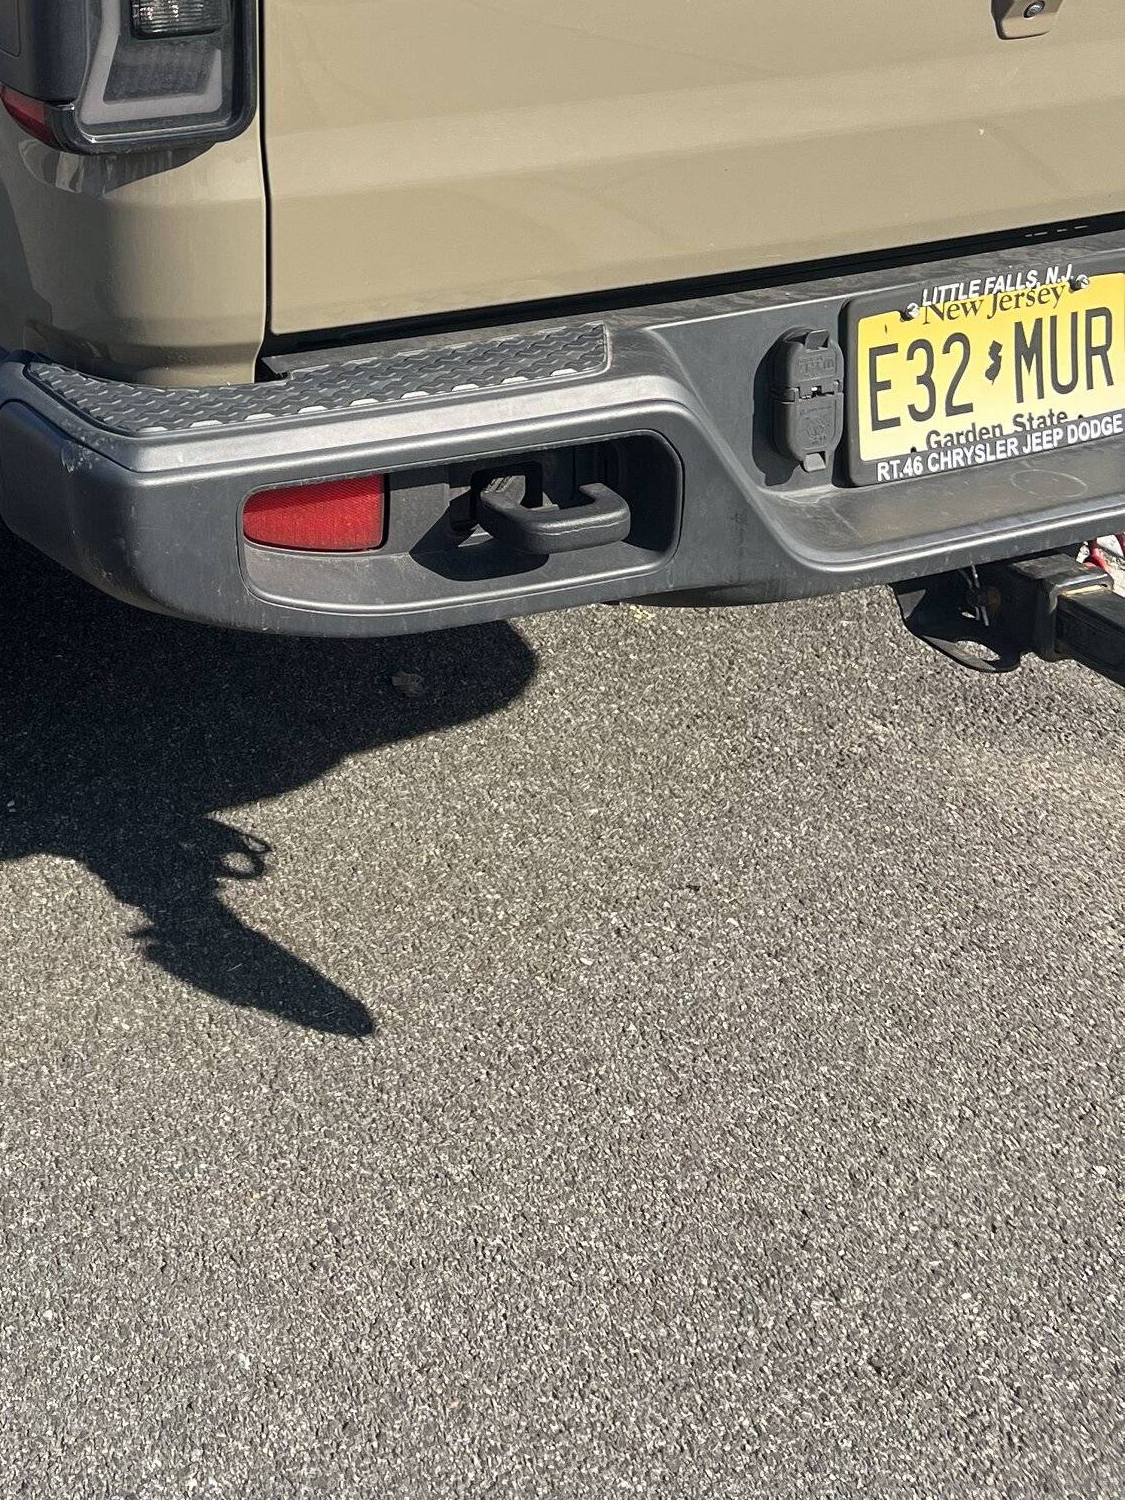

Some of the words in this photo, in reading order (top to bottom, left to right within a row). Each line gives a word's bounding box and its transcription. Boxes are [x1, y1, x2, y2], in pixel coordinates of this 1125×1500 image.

[922, 279, 981, 308] LITTLE
[1045, 263, 1074, 285] N.J.
[923, 299, 985, 325] New
[987, 284, 1066, 319] Jersey
[868, 332, 974, 431] E32
[1014, 306, 1115, 404] MUR
[877, 456, 924, 482] RT.46
[927, 437, 1019, 473] CHRYSLER
[1023, 428, 1064, 455] JEEP
[1067, 414, 1124, 443] DODGE
[926, 422, 1004, 450] Garden
[1012, 408, 1069, 434] State
